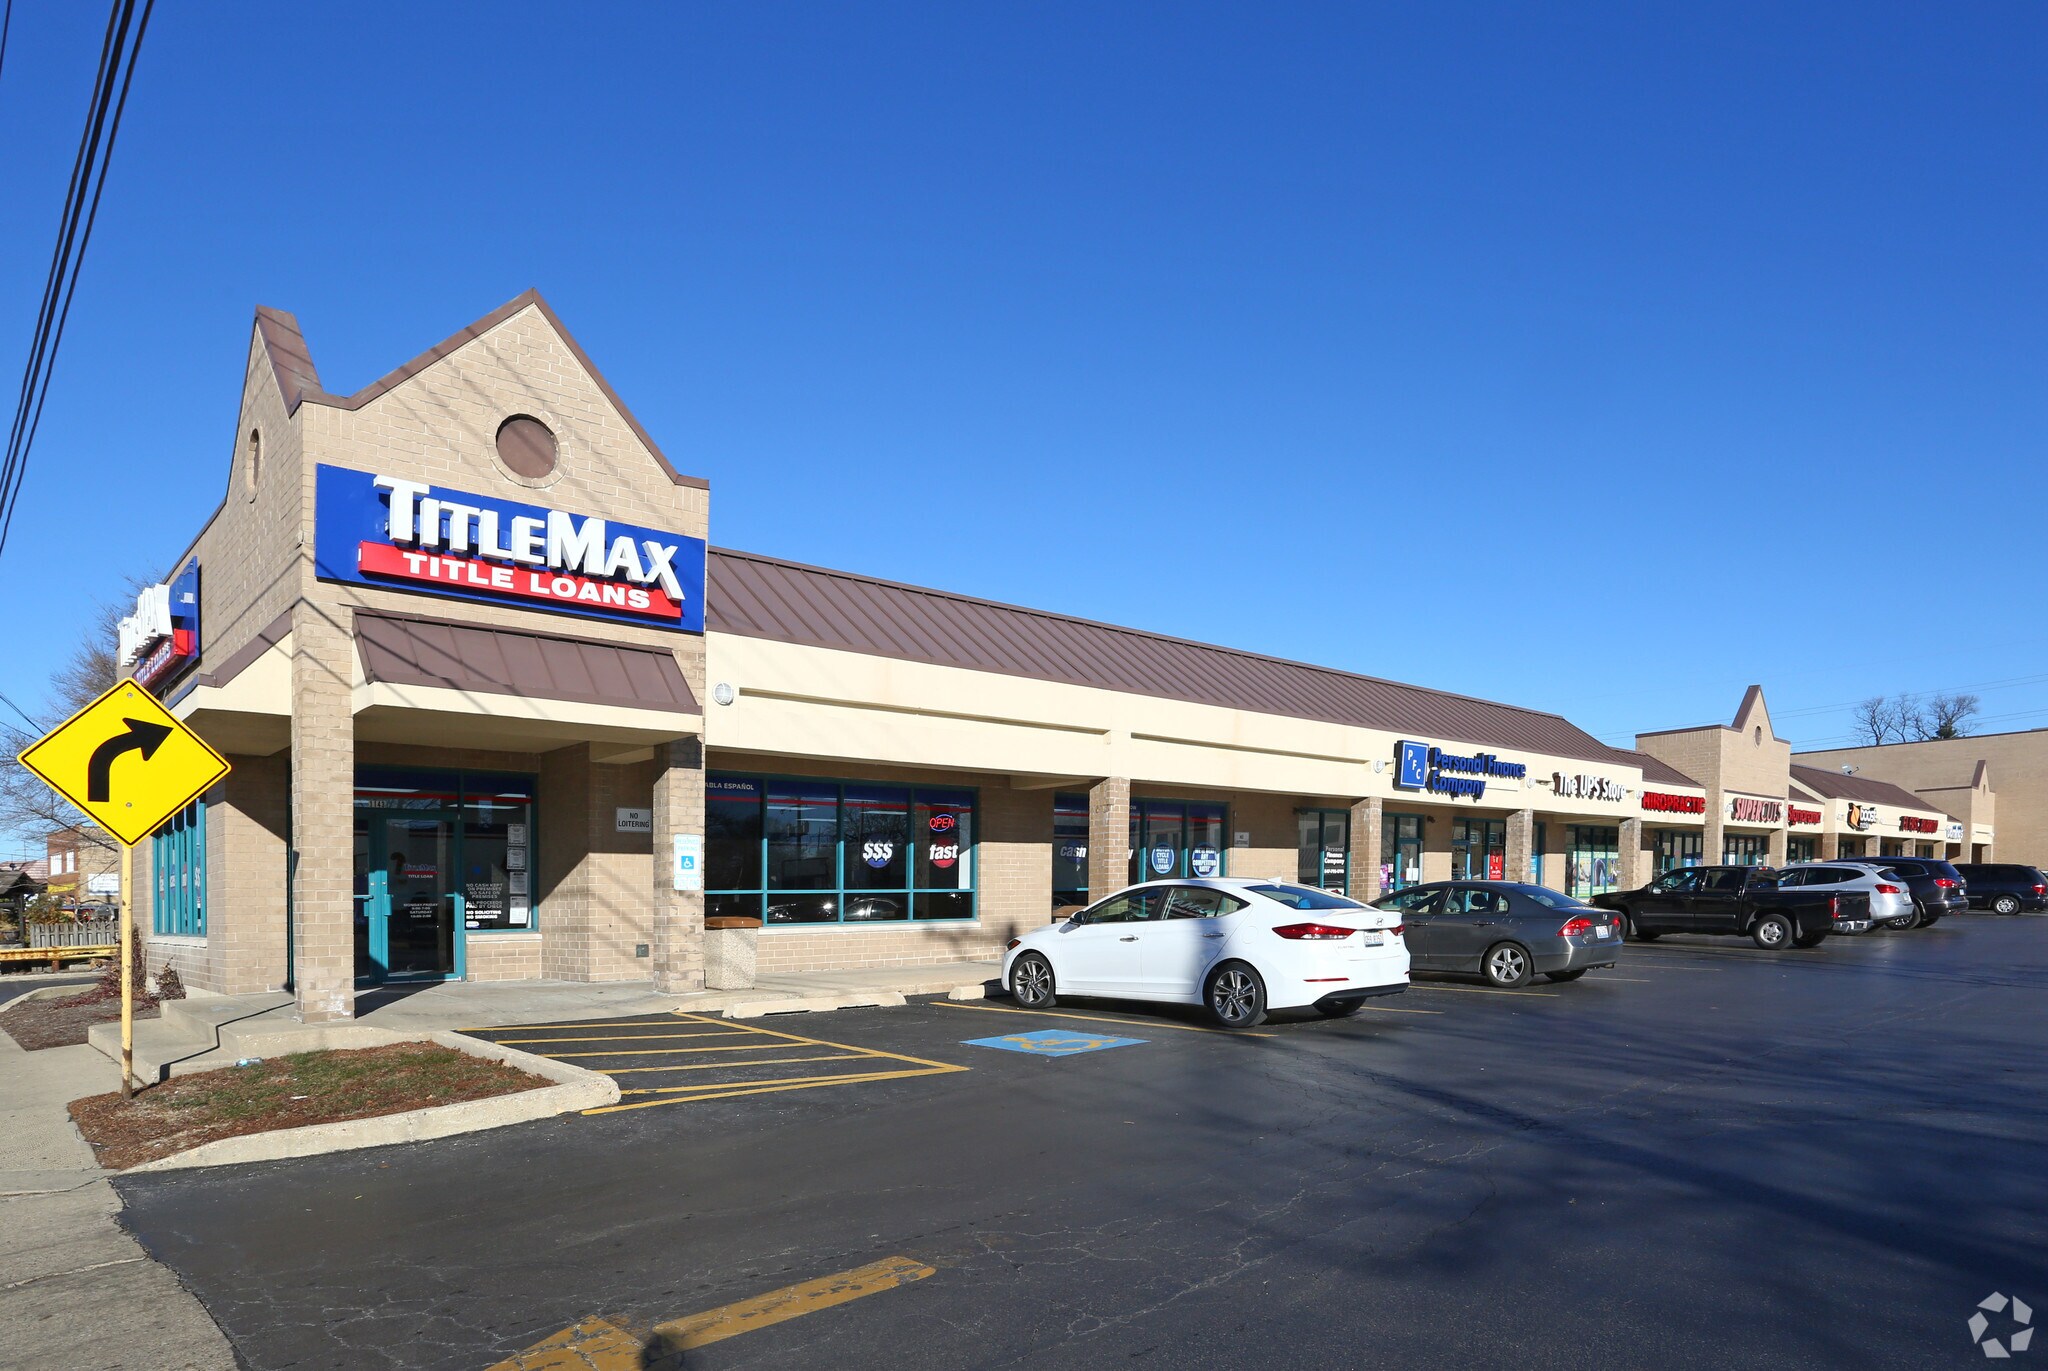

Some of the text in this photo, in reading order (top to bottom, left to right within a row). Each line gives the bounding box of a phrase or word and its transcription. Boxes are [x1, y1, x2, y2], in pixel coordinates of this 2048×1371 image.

[402, 551, 651, 609] TITLE LOANS
[1432, 747, 1527, 778] Personal Finance
[723, 782, 754, 790] ESPAÑOL
[1431, 770, 1487, 800] Company
[1559, 772, 1627, 800] The UPS Store
[1735, 798, 1782, 821] SUPERCUTS
[1860, 807, 1877, 823] boost
[618, 820, 650, 828] LOITERING
[929, 817, 955, 828] OPEN
[862, 839, 894, 862] $$$
[929, 843, 959, 860] fast
[1060, 845, 1087, 858] cash
